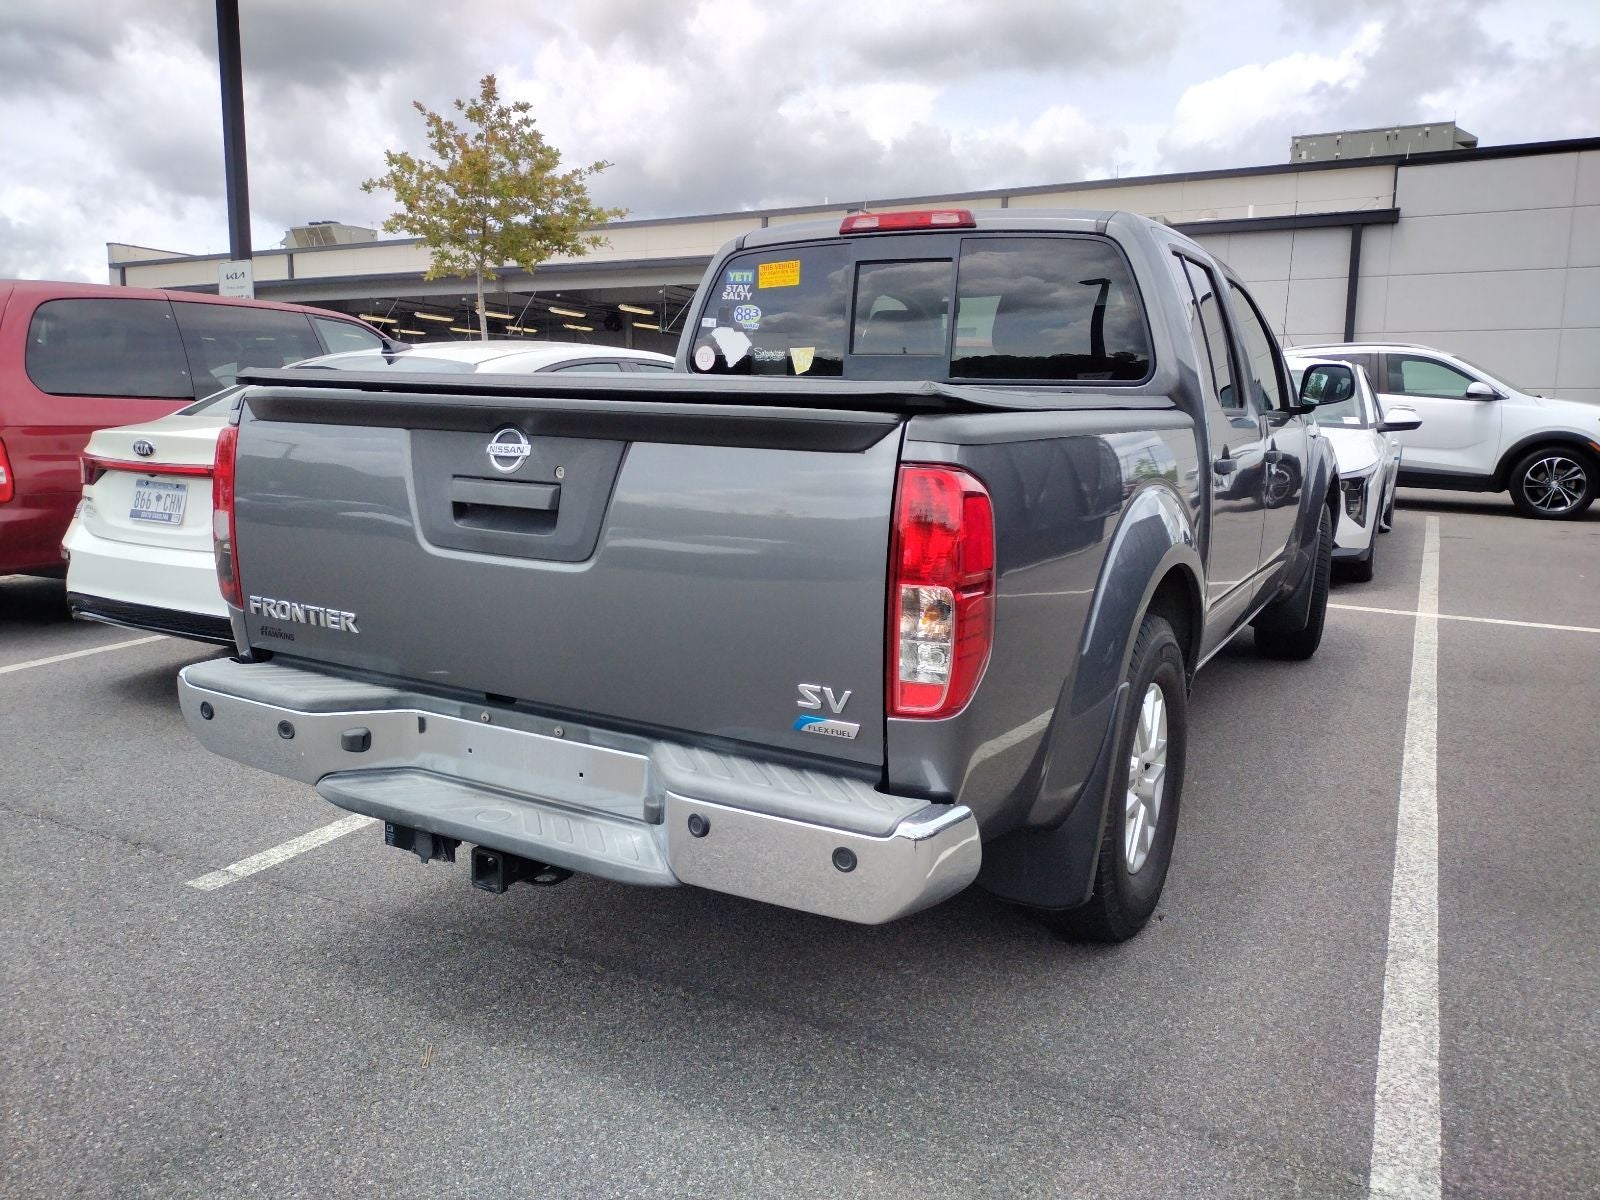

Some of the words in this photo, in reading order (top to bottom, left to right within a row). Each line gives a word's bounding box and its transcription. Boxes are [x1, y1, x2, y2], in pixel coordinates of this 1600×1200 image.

[774, 261, 799, 270] VEHICLE
[728, 271, 753, 282] YETI
[725, 284, 751, 293] STAY
[722, 292, 752, 300] SALTY
[134, 444, 153, 455] KIA
[489, 445, 525, 454] NISSAN
[134, 490, 152, 510] 866
[163, 493, 183, 512] CHN
[249, 595, 361, 634] FRONTIER
[260, 626, 295, 641] HAWKINS
[797, 683, 852, 714] SV
[808, 725, 831, 734] FLEX
[831, 728, 853, 738] FUEL
